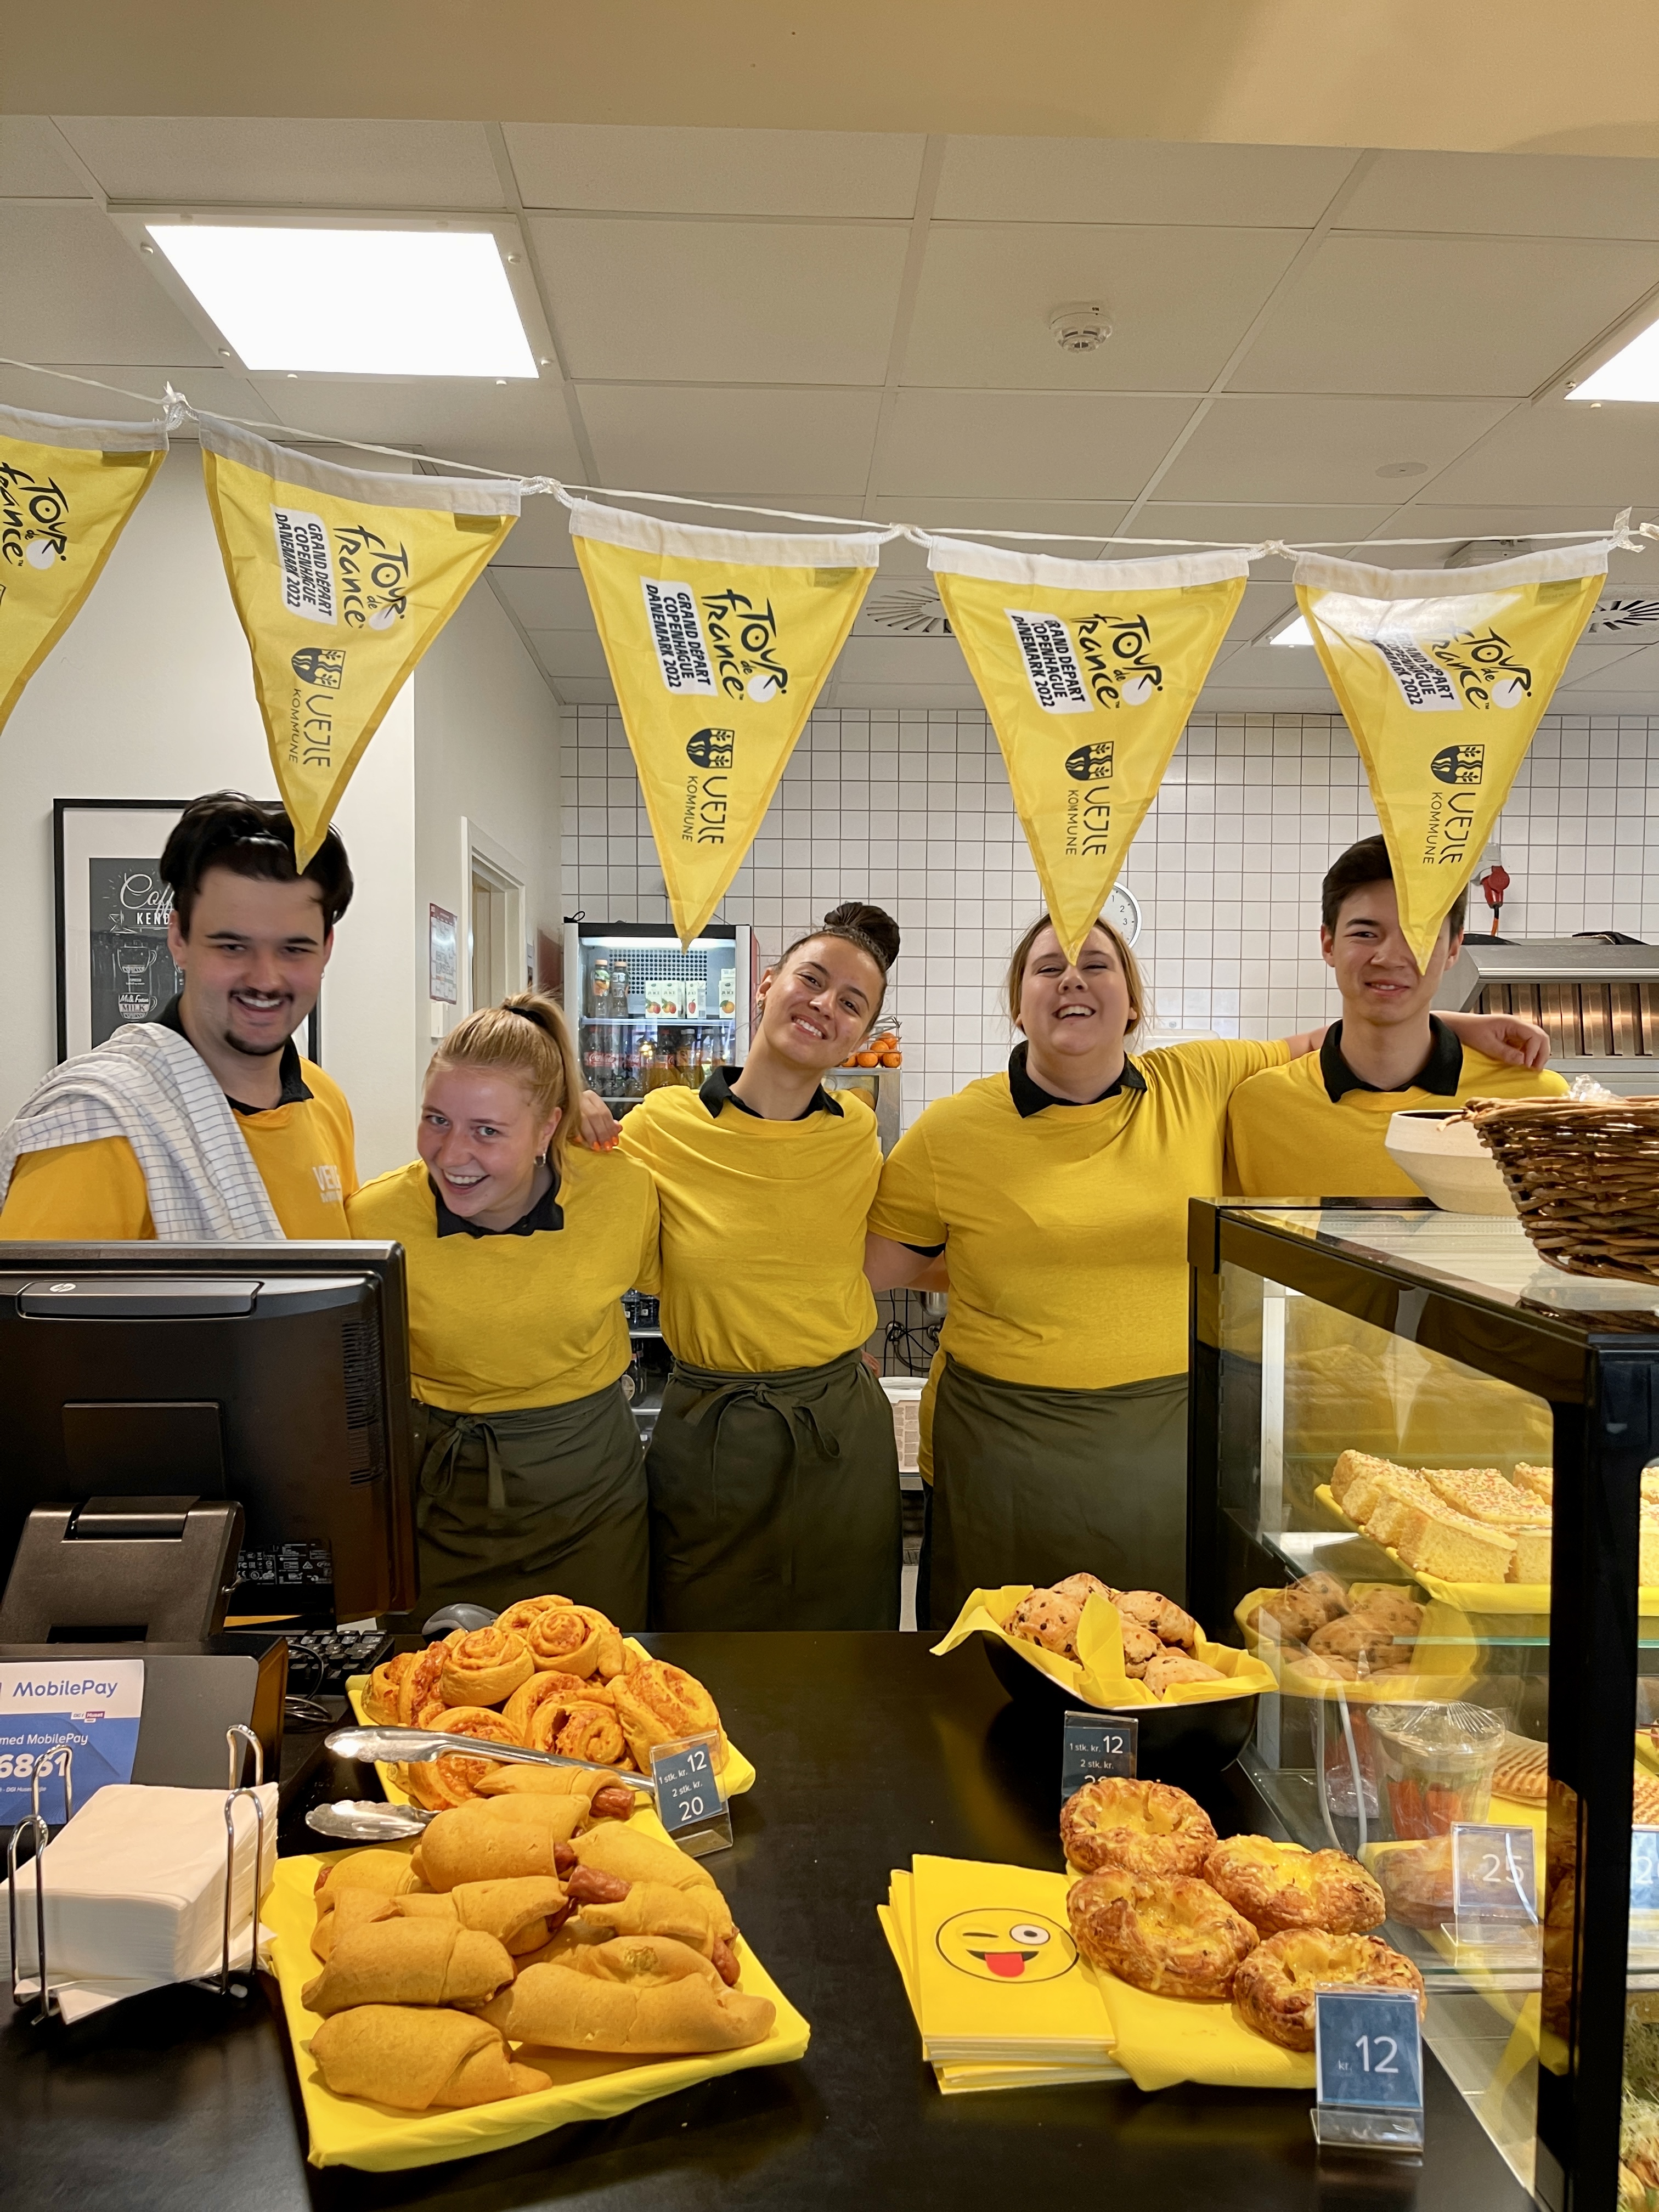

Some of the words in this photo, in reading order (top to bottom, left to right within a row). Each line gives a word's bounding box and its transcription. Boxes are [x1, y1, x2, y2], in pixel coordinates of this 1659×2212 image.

[275, 512, 300, 578] DANEMARK
[294, 526, 316, 606] COPENHAGUE
[308, 523, 327, 569] GRAND
[286, 575, 301, 607] 2022
[315, 570, 332, 616] DÉPART
[646, 584, 675, 657] DANEMARK
[663, 659, 682, 687] 2022
[663, 596, 695, 679] COPENHAGUE
[677, 592, 698, 639] GRAND
[688, 641, 711, 686] DÉPART
[736, 597, 788, 690] TOUR
[1108, 614, 1162, 690] TOUR
[741, 660, 757, 675] de
[1058, 656, 1086, 702] DÉPART
[1113, 669, 1131, 682] de
[1460, 627, 1531, 693] TOUR
[1480, 668, 1499, 682] de
[1034, 680, 1056, 707] 2022
[1400, 678, 1424, 705] 2022
[289, 688, 302, 763] KOMMUNE
[303, 694, 334, 767] VEJLE
[682, 776, 698, 842] KOMMUNE
[697, 776, 727, 844] VEJLE
[1065, 789, 1079, 855] KOMMUNE
[1081, 786, 1110, 856] VEJLE
[1423, 792, 1443, 864] KOMMUNE
[1438, 792, 1476, 864] VEJLE
[120, 872, 176, 919] Coff
[137, 912, 170, 925] KEND
[12, 1680, 119, 1698] MobilePay
[27, 1733, 88, 1746] MobilePay
[1075, 1743, 1089, 1752] stk.
[1103, 1735, 1124, 1754] 12
[659, 1776, 663, 1785] 1
[664, 1773, 678, 1783] stk.
[678, 1769, 688, 1778] kr.
[687, 1751, 707, 1773] 12
[1080, 1759, 1086, 1768] 2
[1088, 1760, 1102, 1769] stk.
[1104, 1761, 1114, 1769] kr.
[672, 1789, 678, 1797] 2
[679, 1784, 692, 1795] stk.
[693, 1780, 703, 1789] kr.
[679, 1796, 704, 1822] 20
[1482, 1853, 1525, 1883] 25
[1635, 1856, 1659, 1885] 2
[1355, 2035, 1399, 2073] 12
